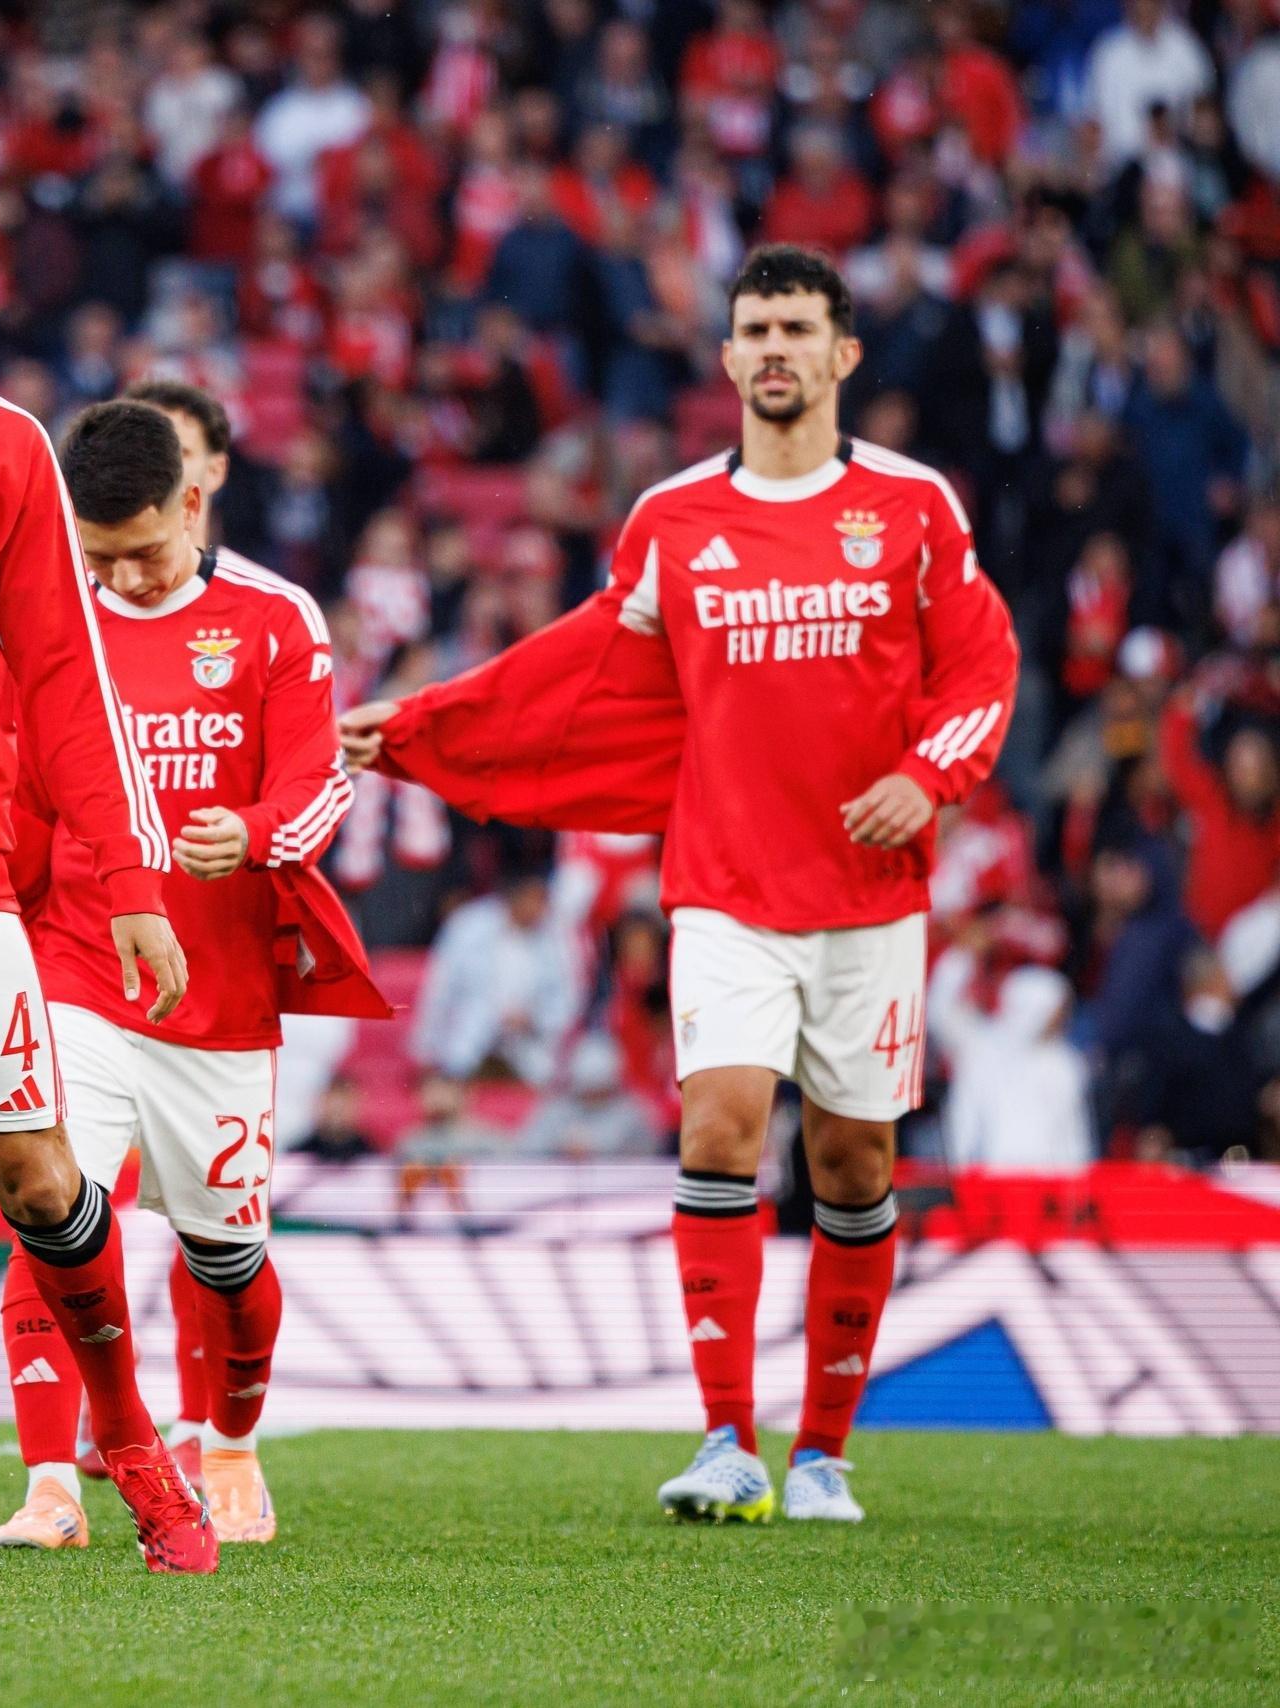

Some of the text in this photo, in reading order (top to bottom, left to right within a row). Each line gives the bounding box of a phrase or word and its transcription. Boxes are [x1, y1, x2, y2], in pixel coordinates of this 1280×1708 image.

[693, 578, 892, 629] Emirates
[726, 621, 863, 666] FLY BETTER
[122, 704, 244, 749] irates
[144, 753, 218, 791] ETTER
[0, 991, 40, 1072] 4
[207, 1109, 272, 1189] 25
